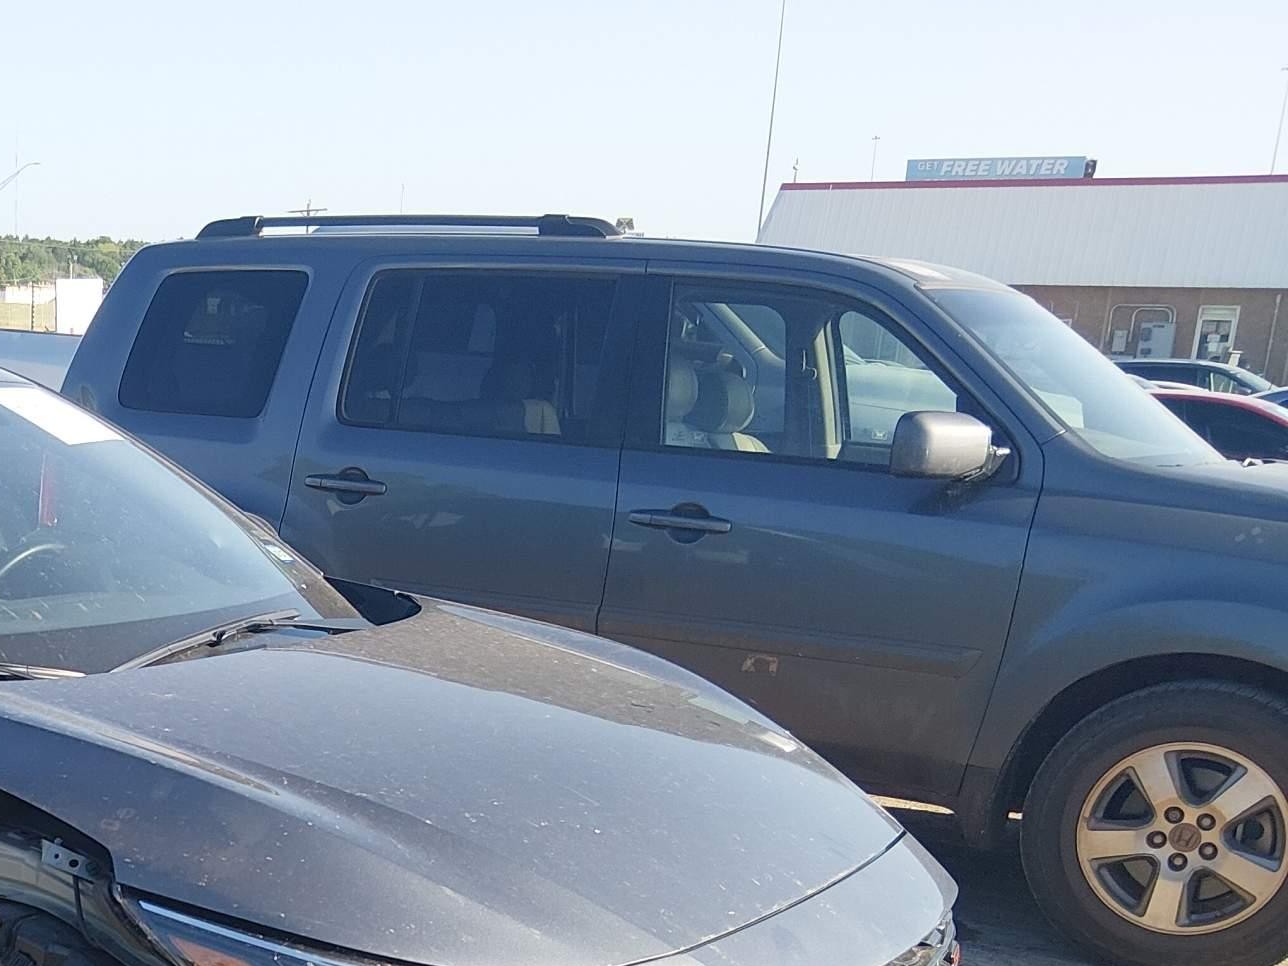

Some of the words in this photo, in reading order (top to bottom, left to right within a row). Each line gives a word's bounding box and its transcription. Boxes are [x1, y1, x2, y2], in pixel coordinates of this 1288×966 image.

[918, 161, 940, 171] GET
[940, 159, 993, 176] FREE
[996, 158, 1069, 176] WATER
